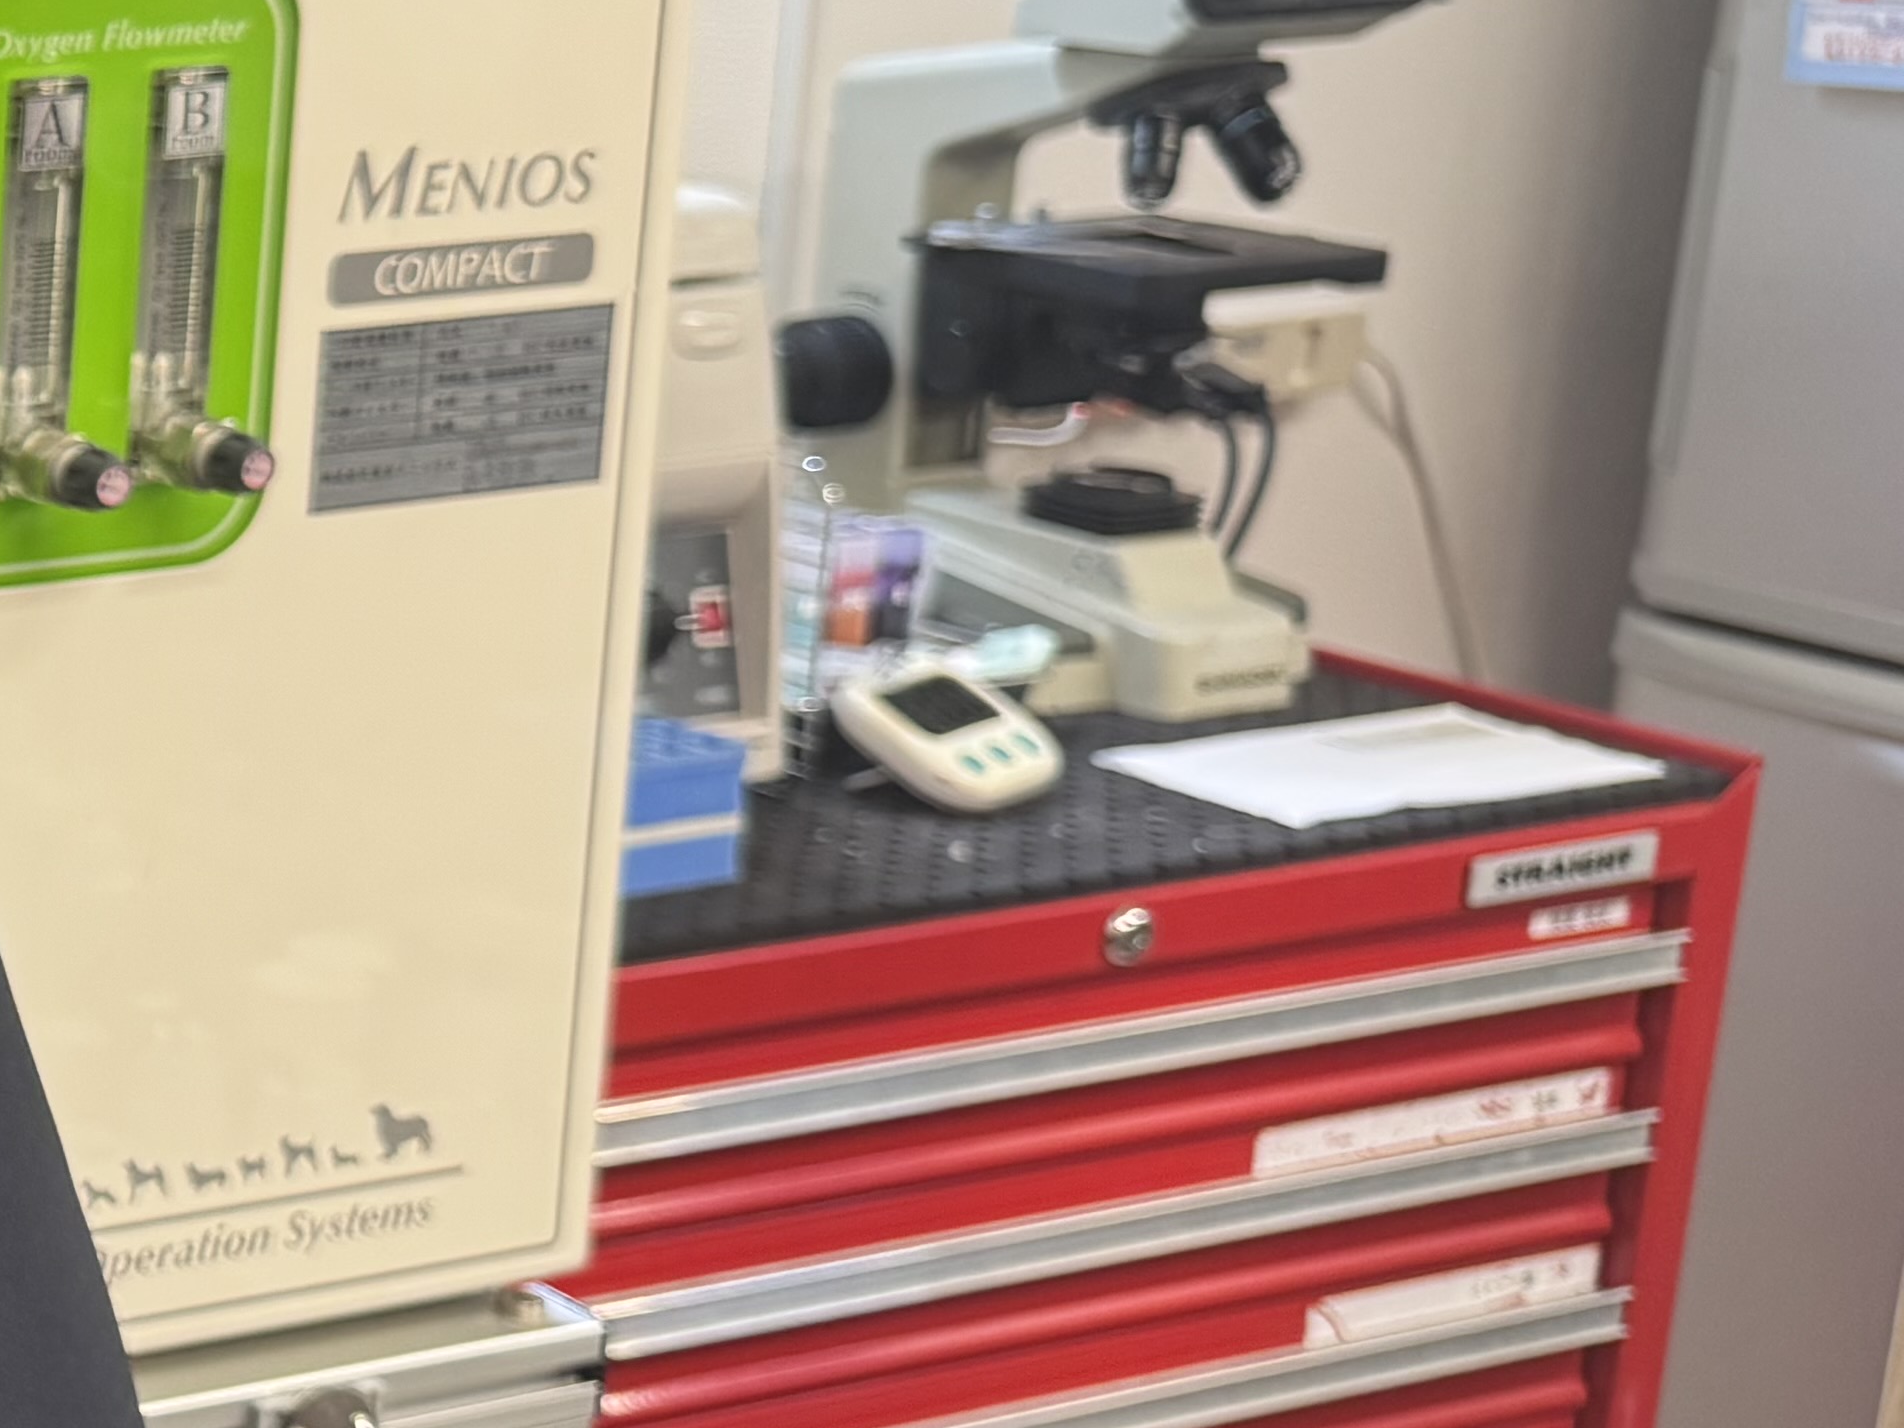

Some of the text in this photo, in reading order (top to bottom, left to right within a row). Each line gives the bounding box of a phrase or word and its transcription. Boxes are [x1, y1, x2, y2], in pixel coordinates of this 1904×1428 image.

[101, 16, 249, 52] Flowmeter
[35, 100, 70, 149] A
[183, 90, 211, 135] B
[374, 239, 559, 296] COMPACT
[286, 1195, 435, 1254] Systems
